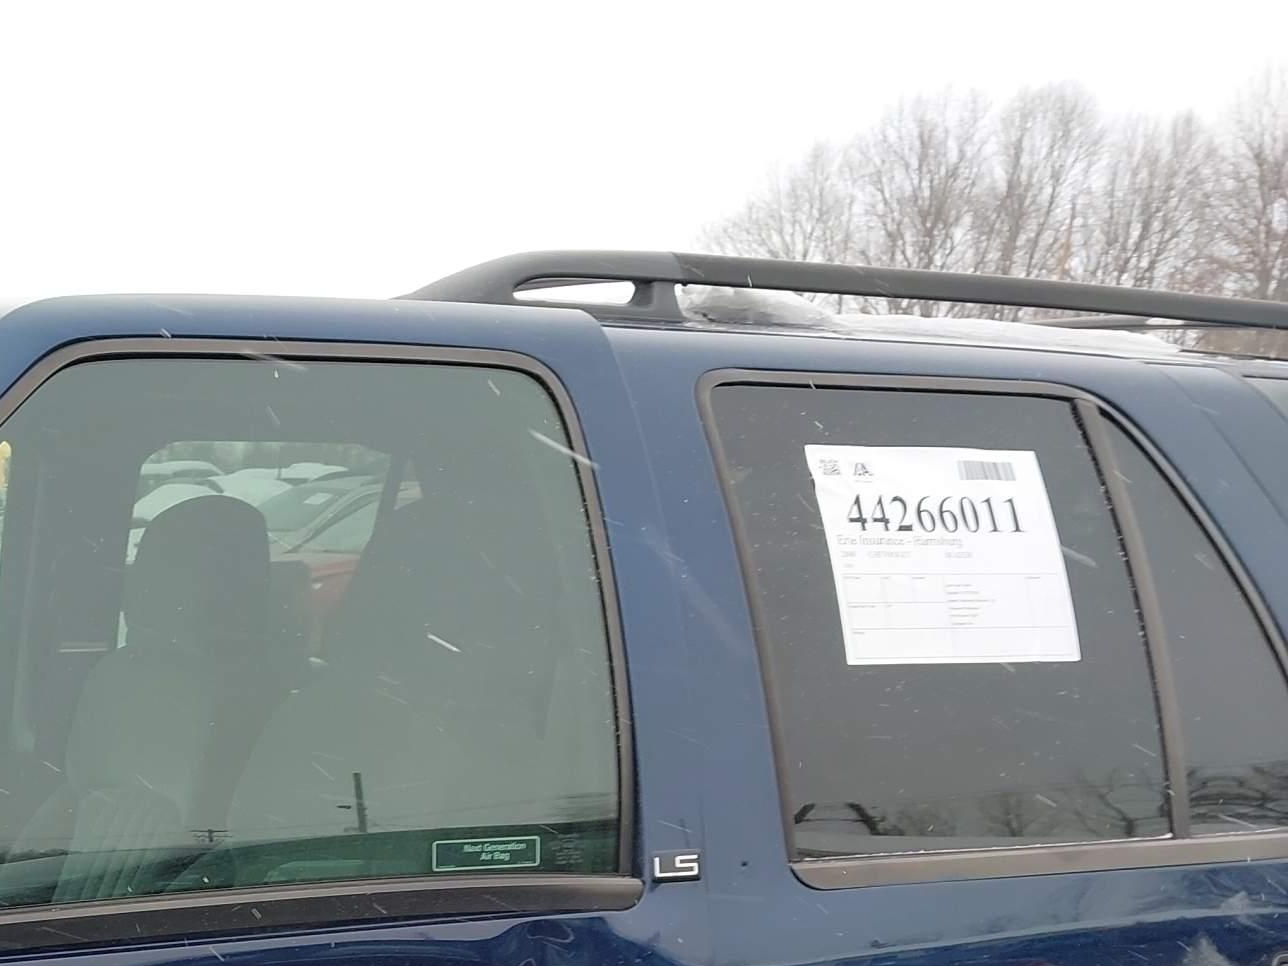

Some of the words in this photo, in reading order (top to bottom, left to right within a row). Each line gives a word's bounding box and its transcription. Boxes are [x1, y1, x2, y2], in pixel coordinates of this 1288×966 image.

[847, 494, 1026, 534] 44266011
[483, 842, 527, 851] Generation
[480, 853, 492, 861] Air
[493, 852, 510, 861] Bag
[654, 854, 699, 878] LS
